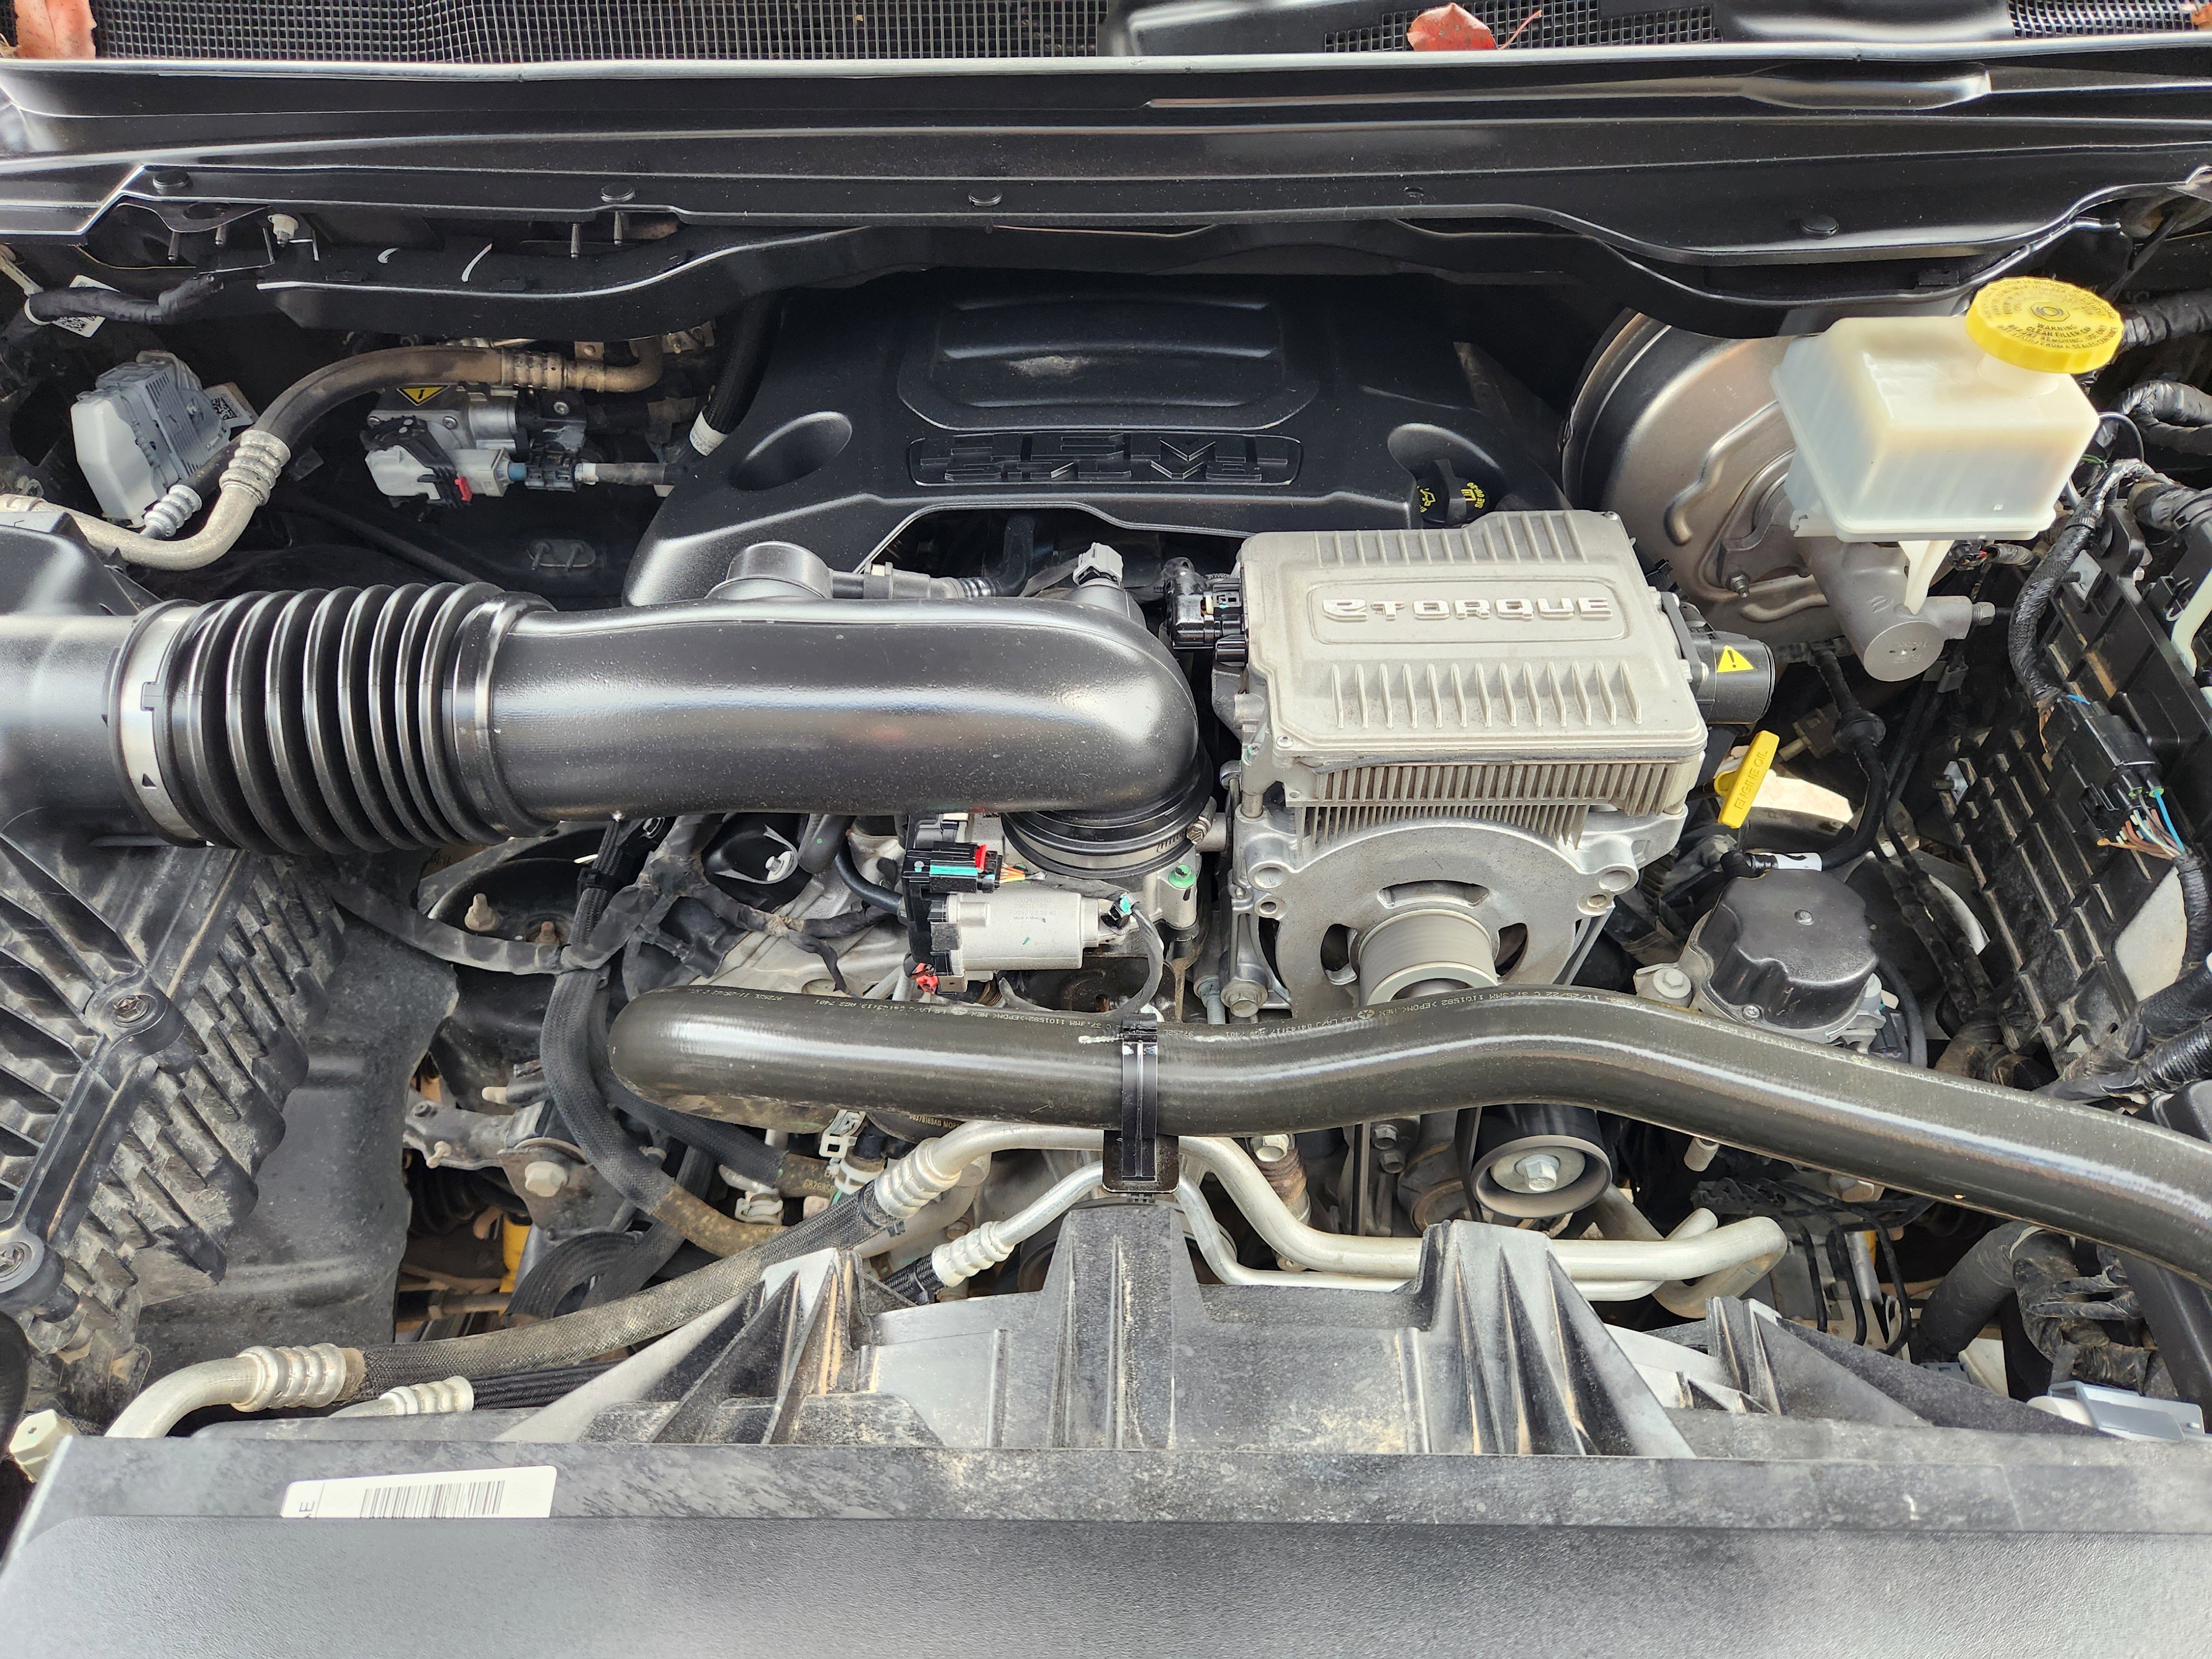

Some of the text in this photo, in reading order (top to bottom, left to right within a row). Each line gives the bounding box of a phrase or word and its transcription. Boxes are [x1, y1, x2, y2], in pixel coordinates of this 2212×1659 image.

[2026, 325, 2092, 337] CLEAN FILLER CAP
[2040, 335, 2083, 343] REMOVING
[1474, 498, 1486, 509] SAE
[1322, 597, 1613, 622] eTORQUE
[1734, 750, 1769, 810] ENGINE OIL
[1028, 1015, 1066, 1025] 1101582
[1162, 1029, 1195, 1038] 97252L
[942, 1120, 961, 1130] MOP
